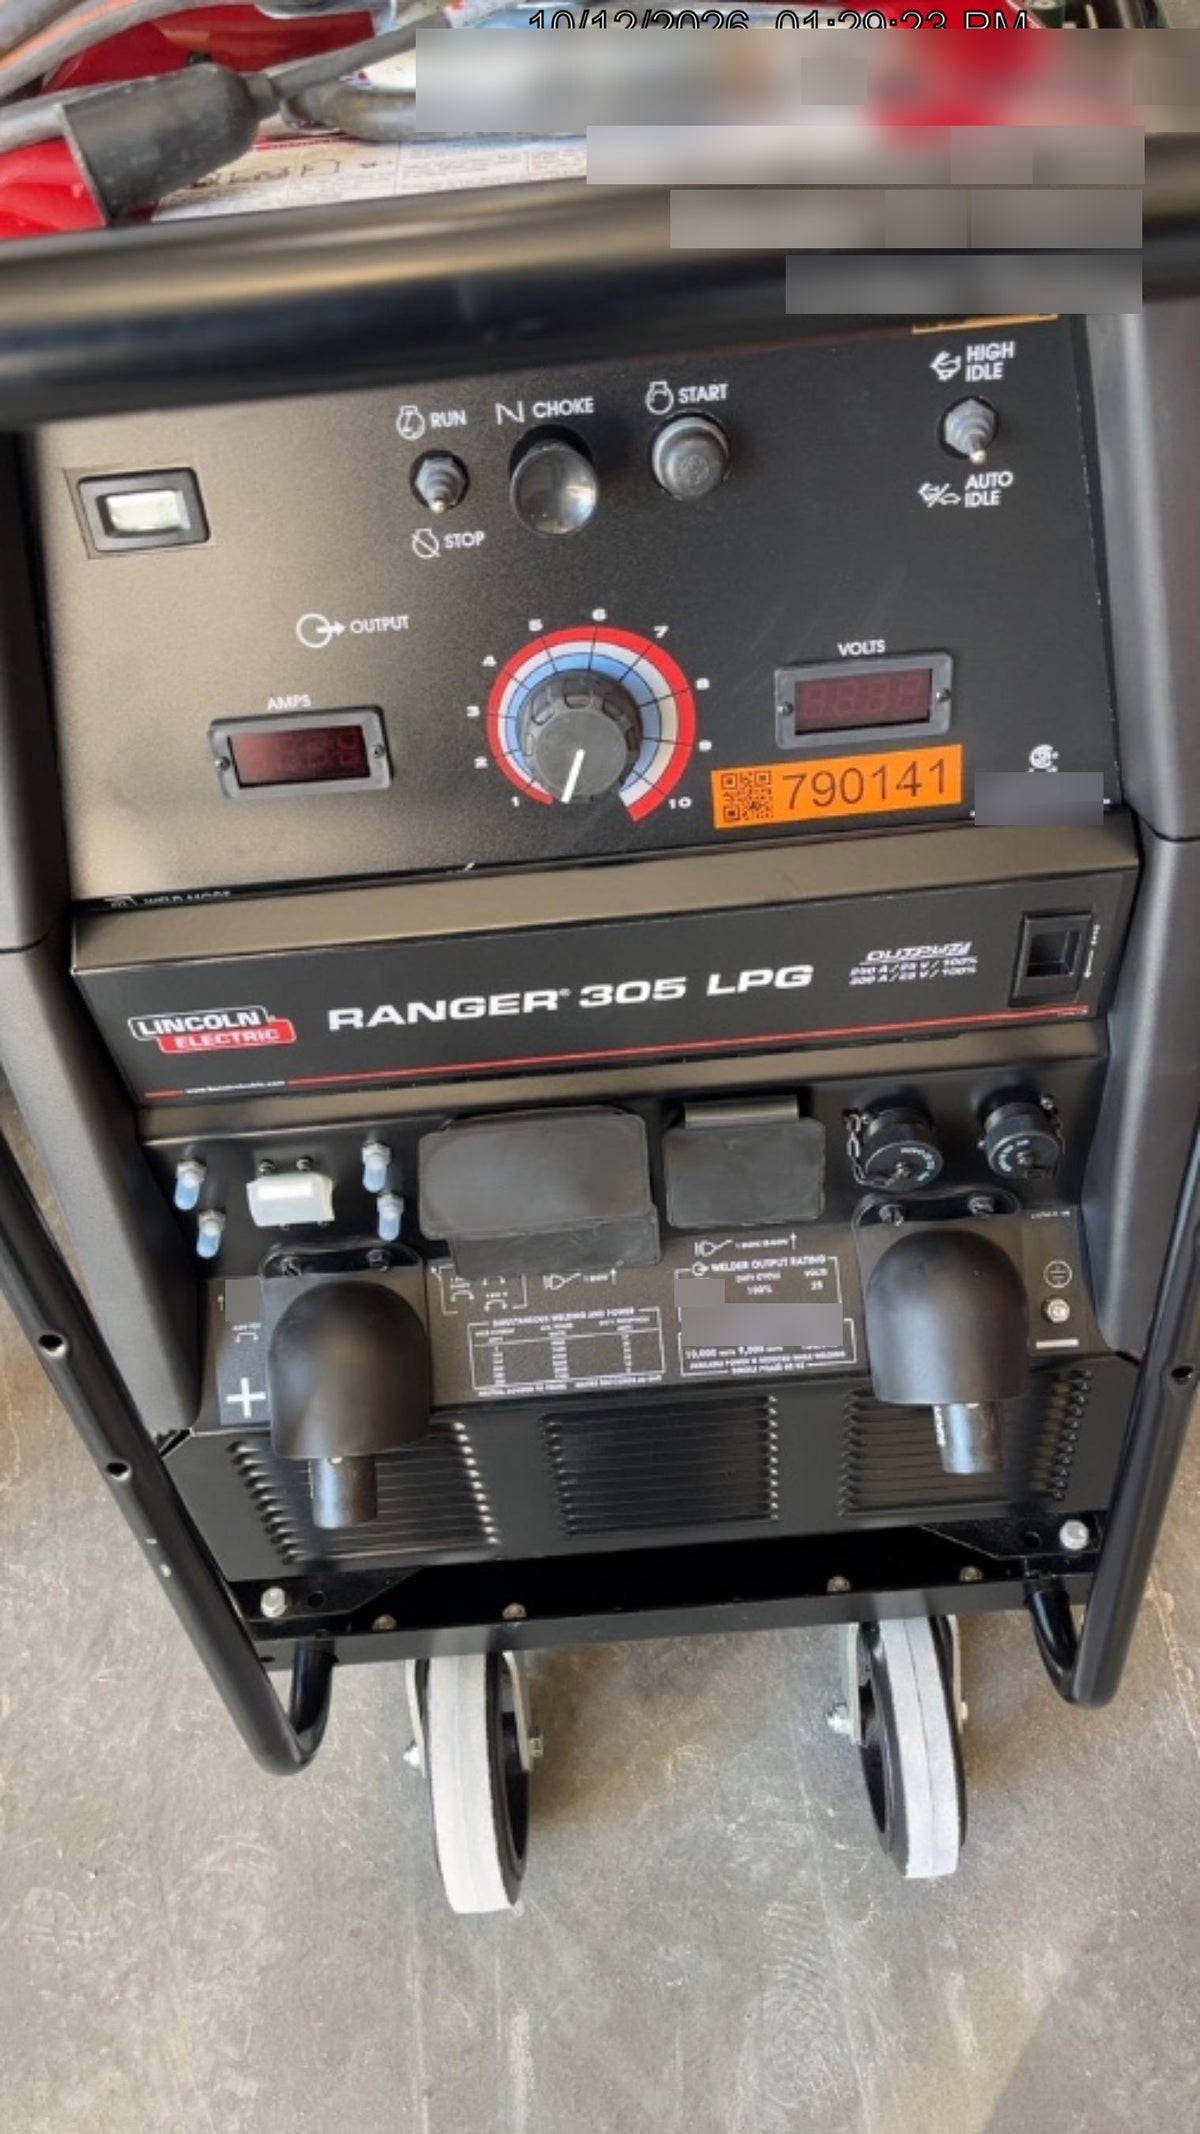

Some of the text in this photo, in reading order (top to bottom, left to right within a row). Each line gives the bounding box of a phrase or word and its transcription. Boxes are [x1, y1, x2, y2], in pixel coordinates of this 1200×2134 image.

[965, 340, 1016, 363] HIGH
[965, 362, 1004, 382] IDLE
[678, 383, 729, 404] START
[532, 396, 595, 419] CHOKE
[430, 410, 467, 429] RUN
[964, 470, 1014, 490] AUTO
[964, 489, 1001, 508] IDLE
[443, 531, 485, 549] STOP
[591, 608, 607, 622] 6
[350, 615, 409, 634] OUTPUT
[528, 618, 543, 632] 5
[653, 625, 669, 638] 7
[837, 639, 886, 657] VOLTS
[481, 655, 497, 667] 4
[695, 677, 710, 690] 8
[267, 694, 312, 711] AMPS
[467, 706, 480, 718] 3
[698, 740, 713, 752] 9
[474, 757, 489, 769] 2
[782, 757, 947, 812] 790141
[511, 796, 520, 807] 1
[668, 796, 692, 810] 10
[579, 977, 687, 1009] 305
[706, 965, 814, 997] LPG
[137, 1011, 261, 1036] LINCOLN
[174, 1028, 280, 1049] ELECTRIC
[752, 1257, 788, 1269] OUTPUT
